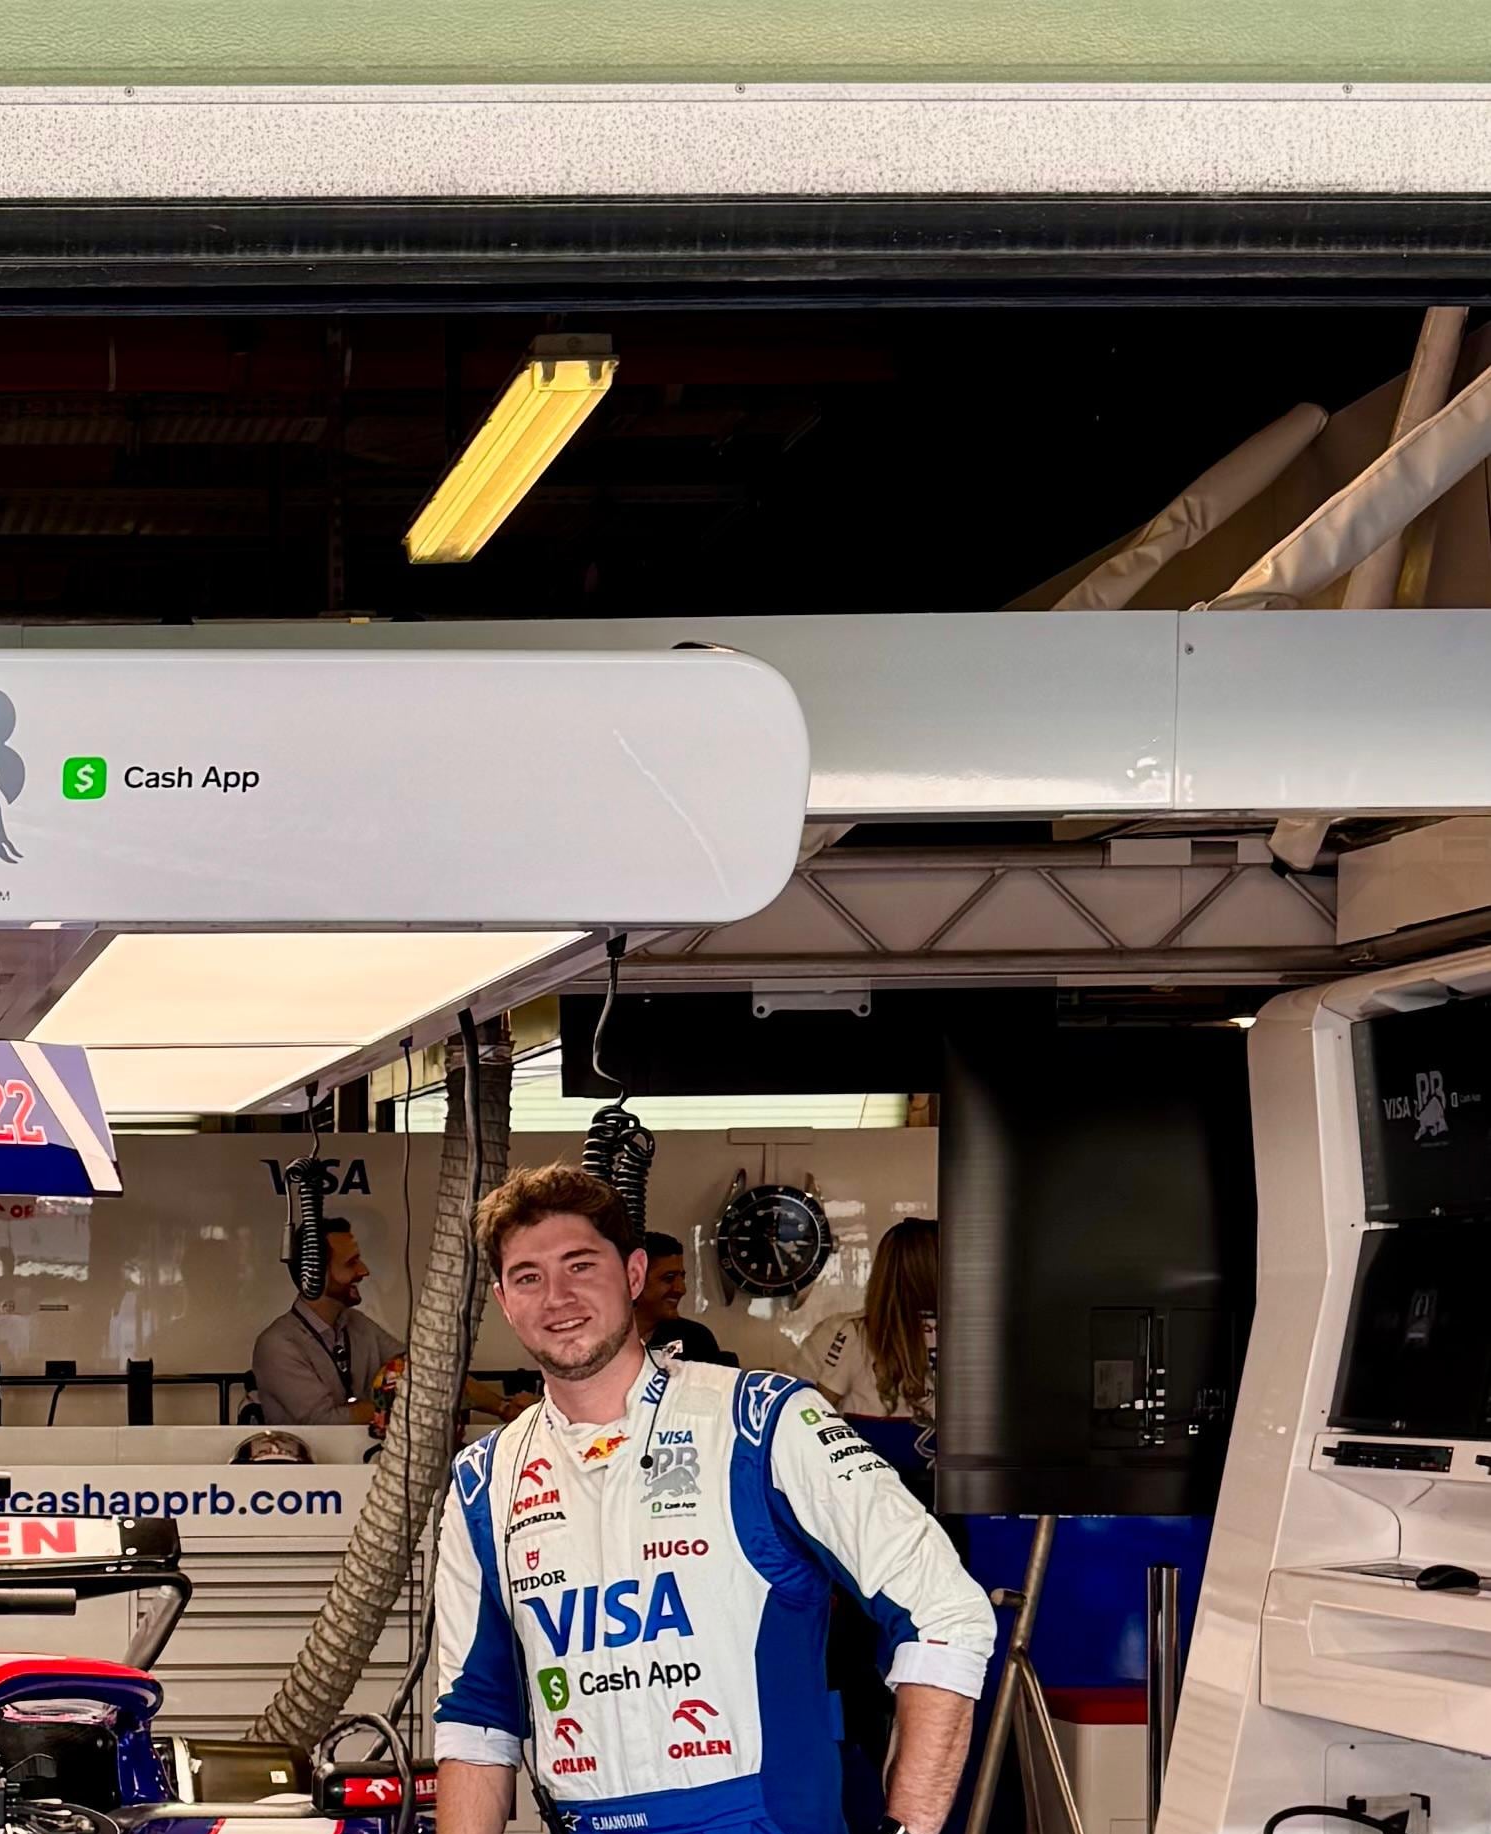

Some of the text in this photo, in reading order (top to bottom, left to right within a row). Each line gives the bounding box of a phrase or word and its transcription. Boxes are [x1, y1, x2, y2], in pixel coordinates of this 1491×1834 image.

[124, 766, 193, 789] Cash
[202, 766, 260, 795] App
[1381, 1096, 1412, 1120] VISA
[259, 1158, 371, 1195] VSA
[640, 1371, 669, 1405] VIS
[656, 1430, 694, 1445] VISA
[513, 1489, 560, 1515] ORLEN
[510, 1511, 566, 1535] HONDA
[642, 1538, 709, 1562] HUGO
[511, 1569, 567, 1594] TUDOR
[520, 1571, 694, 1658] VISA
[579, 1665, 642, 1697] Cash
[648, 1661, 701, 1690] App
[668, 1738, 732, 1760] ORLEN
[552, 1756, 597, 1775] ORLEN
